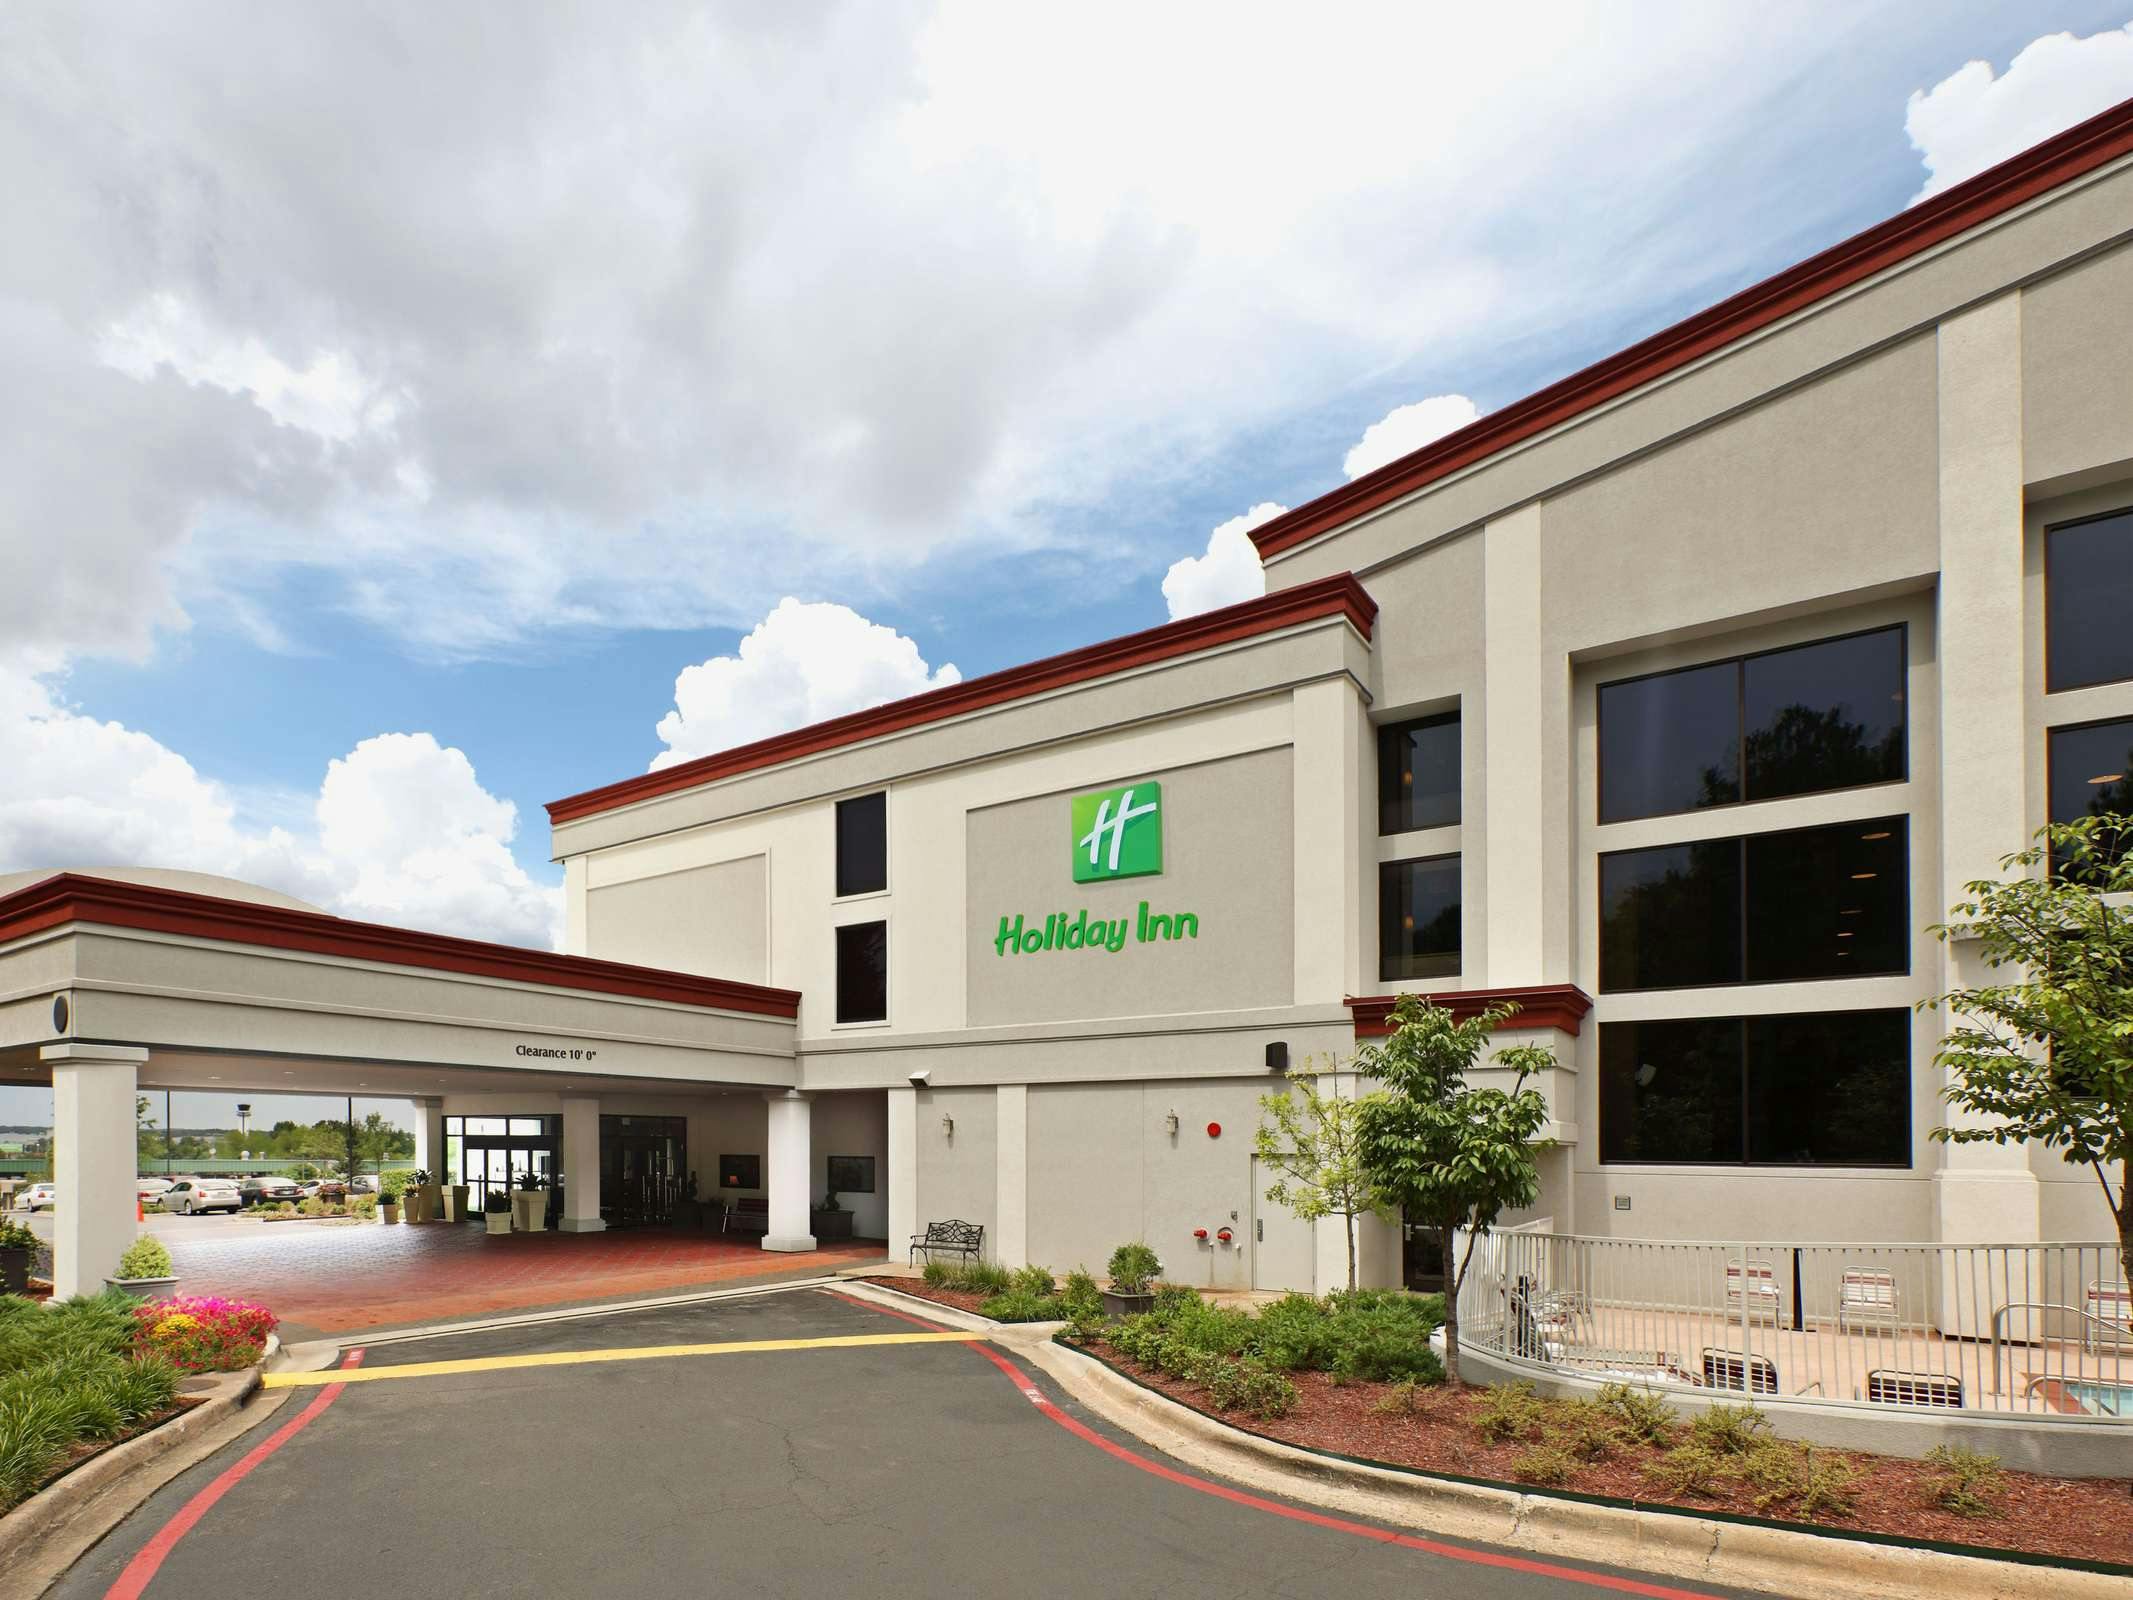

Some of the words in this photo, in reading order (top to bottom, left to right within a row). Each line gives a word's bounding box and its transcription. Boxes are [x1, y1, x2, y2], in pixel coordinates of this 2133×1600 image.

[994, 909, 1128, 957] Holiday
[1136, 901, 1199, 943] Inn
[515, 1044, 567, 1059] Clearance
[569, 1049, 583, 1060] 10'
